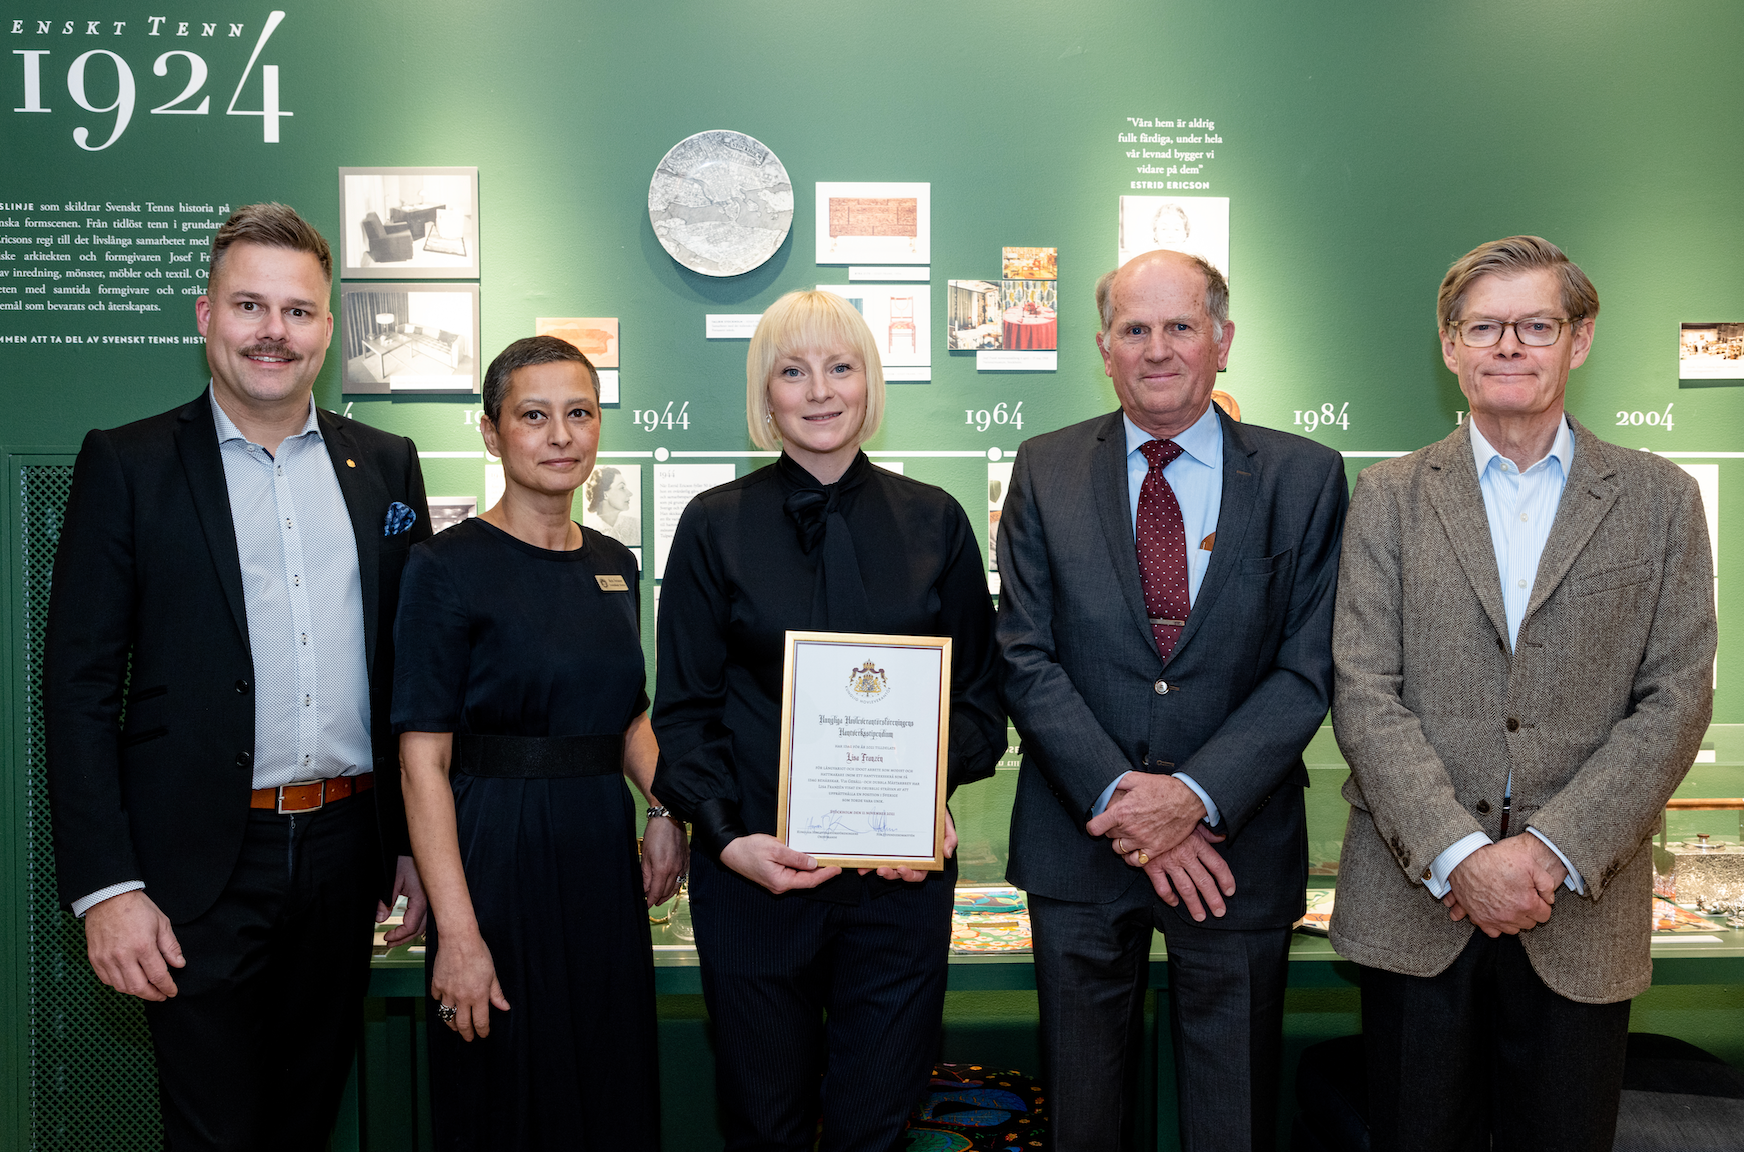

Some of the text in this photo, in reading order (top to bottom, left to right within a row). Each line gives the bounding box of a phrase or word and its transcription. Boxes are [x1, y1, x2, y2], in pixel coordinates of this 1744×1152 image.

[11, 20, 126, 35] ENSKT
[11, 10, 294, 151] 1924
[1155, 118, 1174, 127] hem
[1177, 119, 1186, 127] är
[1189, 118, 1214, 130] aldrig
[1118, 133, 1222, 146] fullt färdiga, under hela
[1126, 149, 1214, 161] vår levnad bygger vi
[1137, 164, 1164, 173] vidare
[1167, 165, 1177, 176] på
[1131, 181, 1164, 189] ESTRID
[65, 202, 101, 211] skildrar
[106, 202, 141, 212] Svenskt
[146, 202, 174, 212] Tenns
[179, 203, 213, 212] historia
[219, 204, 230, 215] på
[0, 217, 20, 227] nska
[25, 217, 80, 227] formscenen.
[87, 219, 107, 228] Från
[113, 219, 142, 228] tidlöst
[174, 220, 177, 228] i
[182, 219, 224, 232] grundare
[37, 235, 53, 247] regi
[58, 235, 70, 244] till
[74, 235, 89, 244] det
[93, 235, 132, 248] livslånga
[136, 235, 185, 245] samarbetet
[190, 236, 209, 245] med
[24, 251, 71, 261] arkitekten
[79, 251, 96, 261] och
[105, 251, 161, 264] formgivaren
[169, 252, 193, 263] Josef
[13, 267, 62, 280] inredning,
[66, 269, 105, 278] mönster,
[109, 268, 141, 278] möbler
[145, 268, 162, 278] och
[166, 269, 192, 278] textil.
[25, 284, 46, 293] med
[54, 284, 90, 294] samtida
[98, 284, 149, 297] formgivare
[157, 285, 174, 294] och
[0, 300, 22, 310] emål
[47, 301, 85, 310] bevarats
[88, 301, 105, 310] och
[108, 301, 161, 313] återskapats.
[148, 336, 179, 344] TENNS
[633, 401, 690, 432] 1944
[965, 401, 1024, 432] 1964
[1293, 401, 1351, 433] 1984
[1616, 403, 1674, 431] 2004
